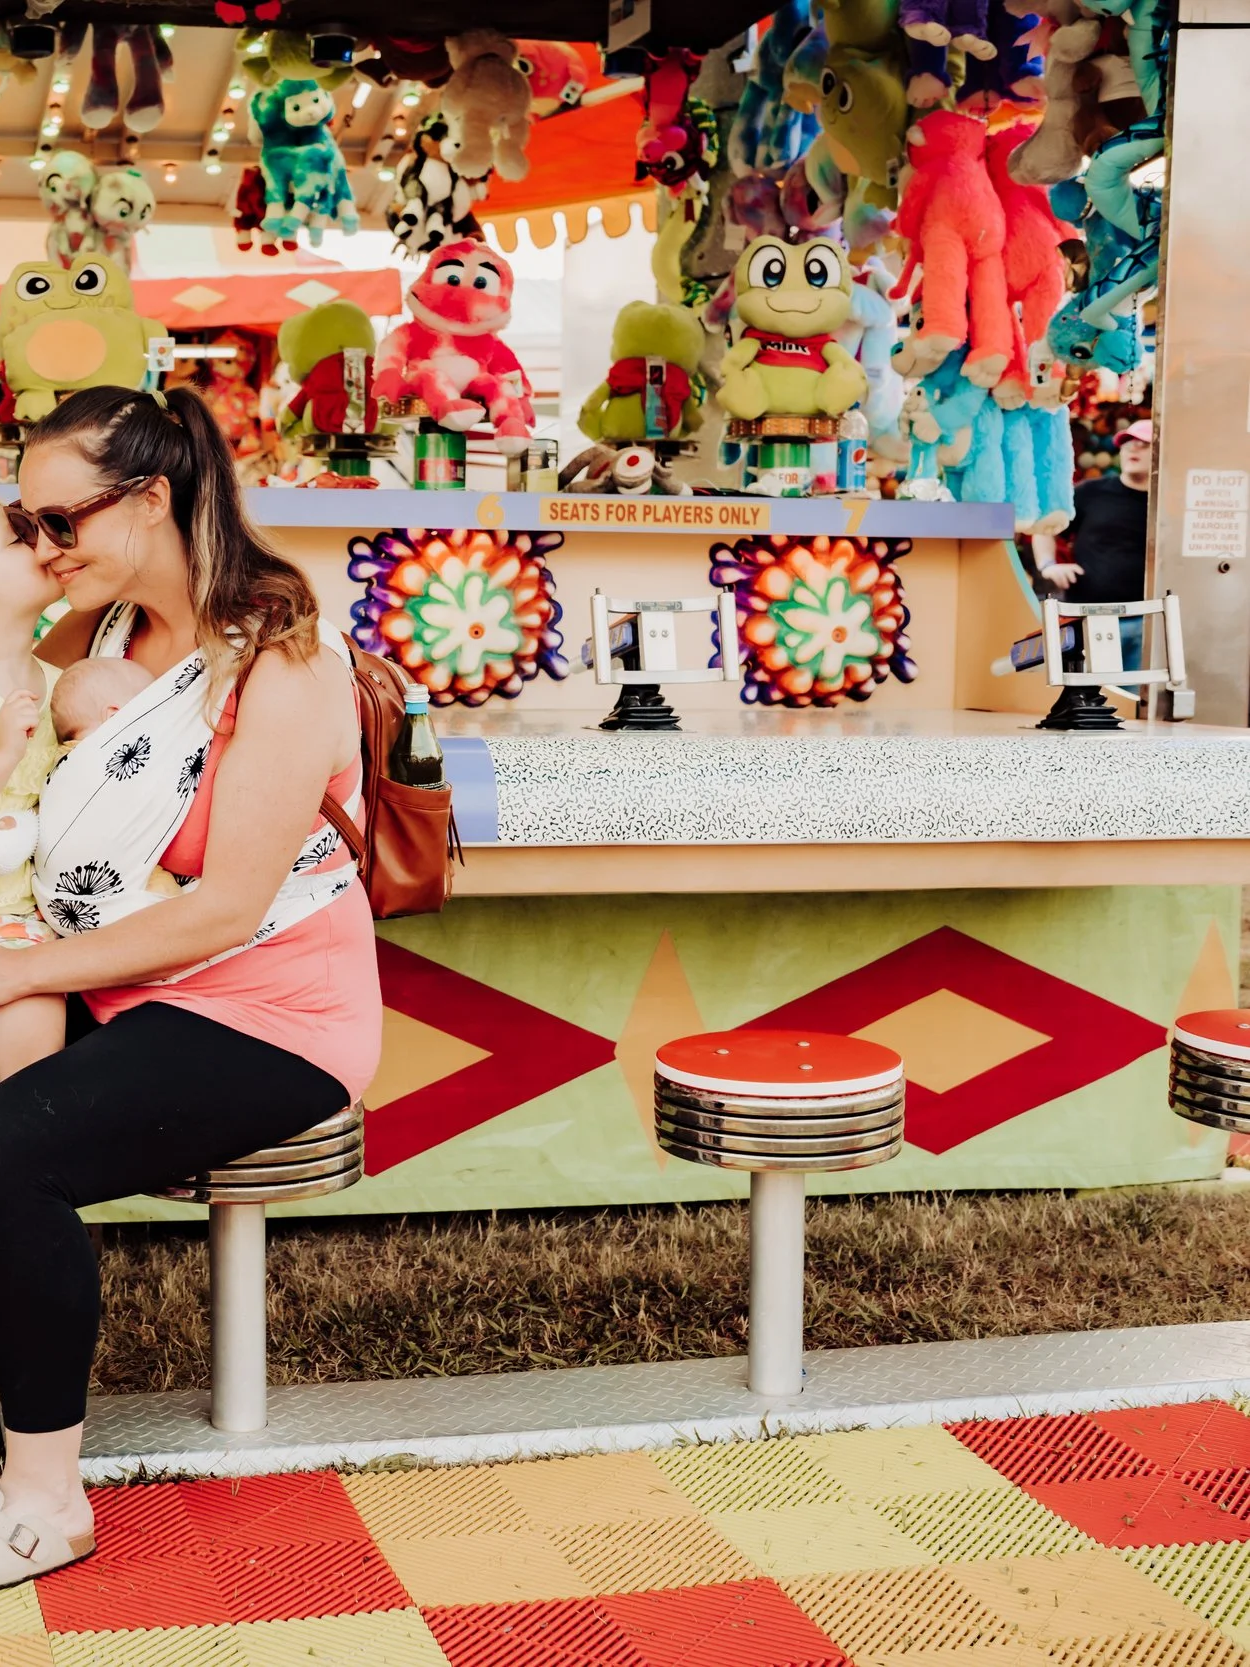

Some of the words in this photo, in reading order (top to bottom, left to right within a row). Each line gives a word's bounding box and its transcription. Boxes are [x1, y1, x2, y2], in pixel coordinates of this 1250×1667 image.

[1192, 475, 1211, 486] DO
[1216, 475, 1244, 487] NOT
[476, 493, 505, 528] 6
[549, 502, 599, 521] SEATS
[606, 503, 637, 522] FOR
[642, 504, 713, 524] PLAYERS
[718, 506, 760, 526] ONLY
[841, 499, 871, 535] 7
